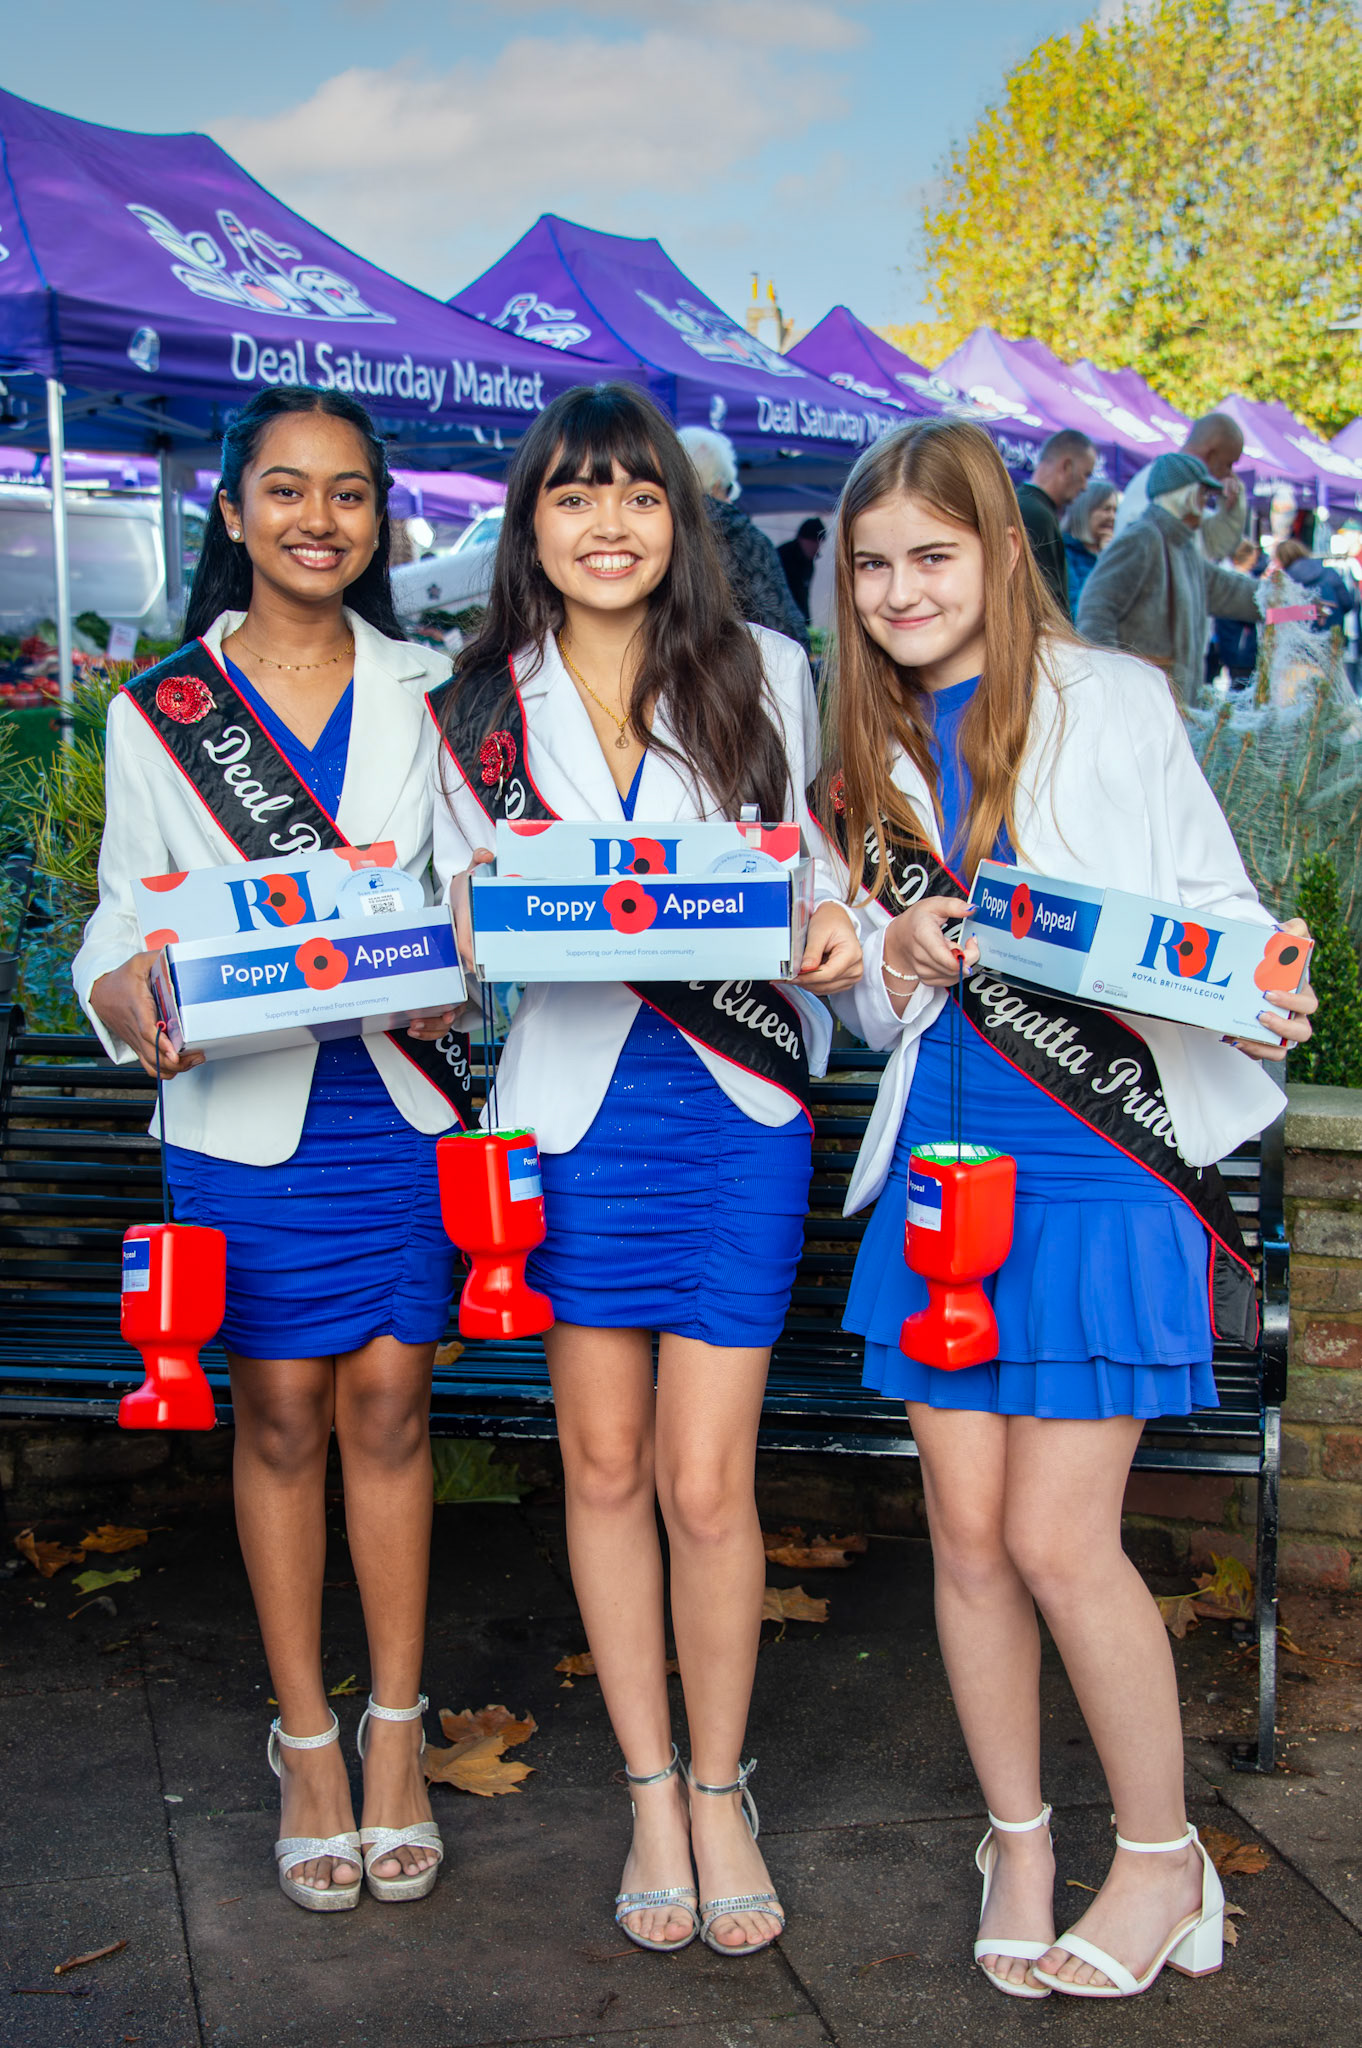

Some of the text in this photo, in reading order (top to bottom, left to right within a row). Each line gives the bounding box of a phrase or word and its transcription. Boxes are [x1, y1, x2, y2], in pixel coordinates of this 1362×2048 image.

[230, 332, 545, 413] Deal Saturday Market
[756, 396, 798, 434] Deal
[798, 399, 866, 449] Saturday
[203, 725, 294, 823] Deal
[527, 892, 744, 921] Poppy Appeal
[981, 888, 1077, 933] Poppy Appeal
[221, 936, 430, 987] Poppy Appeal
[566, 949, 600, 957] Supporting
[265, 1009, 299, 1019] Supporting
[312, 1004, 333, 1012] Armed
[334, 1001, 355, 1009] Forces
[356, 996, 390, 1006] community
[1132, 972, 1225, 1001] ROYAL BRITISH LEGION
[713, 980, 800, 1060] Queen
[969, 973, 1093, 1074] egatta
